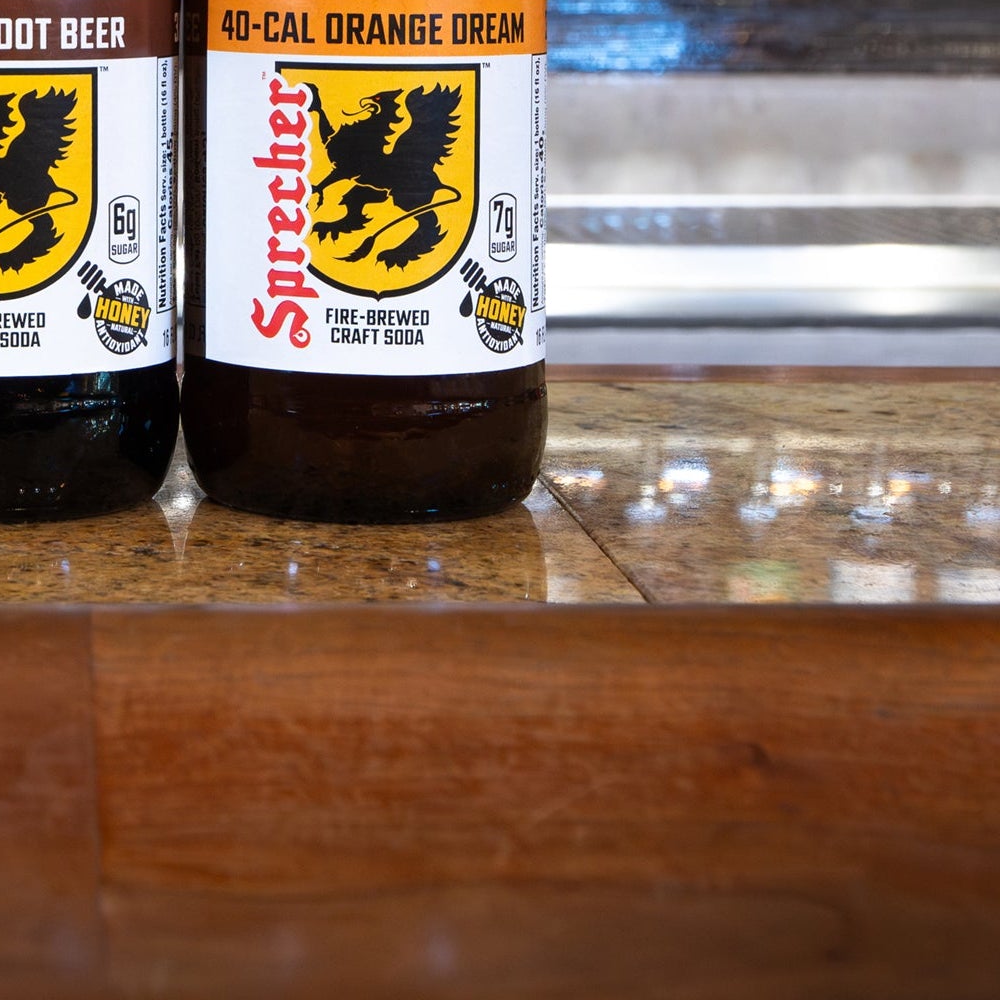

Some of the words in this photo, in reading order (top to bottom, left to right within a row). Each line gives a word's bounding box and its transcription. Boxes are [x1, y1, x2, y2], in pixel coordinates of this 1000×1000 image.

[60, 16, 126, 50] BEER
[221, 10, 315, 44] 40-CAL
[325, 13, 443, 45] ORANGE
[452, 12, 525, 45] DREAM
[160, 90, 168, 106] (16
[113, 203, 136, 241] 6g
[251, 78, 320, 349] Sprecher
[493, 200, 513, 239] 7g
[111, 242, 138, 256] SUGAR
[491, 240, 515, 254] SUGAR
[114, 280, 145, 302] MADE
[493, 278, 521, 300] MADE
[95, 296, 151, 329] HONEY
[325, 308, 430, 326] FIRE-BREWED
[475, 294, 527, 328] HONEY
[0, 331, 41, 348] SODA
[95, 319, 145, 353] ANTIOXIDANT
[330, 328, 381, 345] CRAFT
[384, 328, 425, 345] SODA
[475, 317, 521, 352] ANTIOXIDANT
